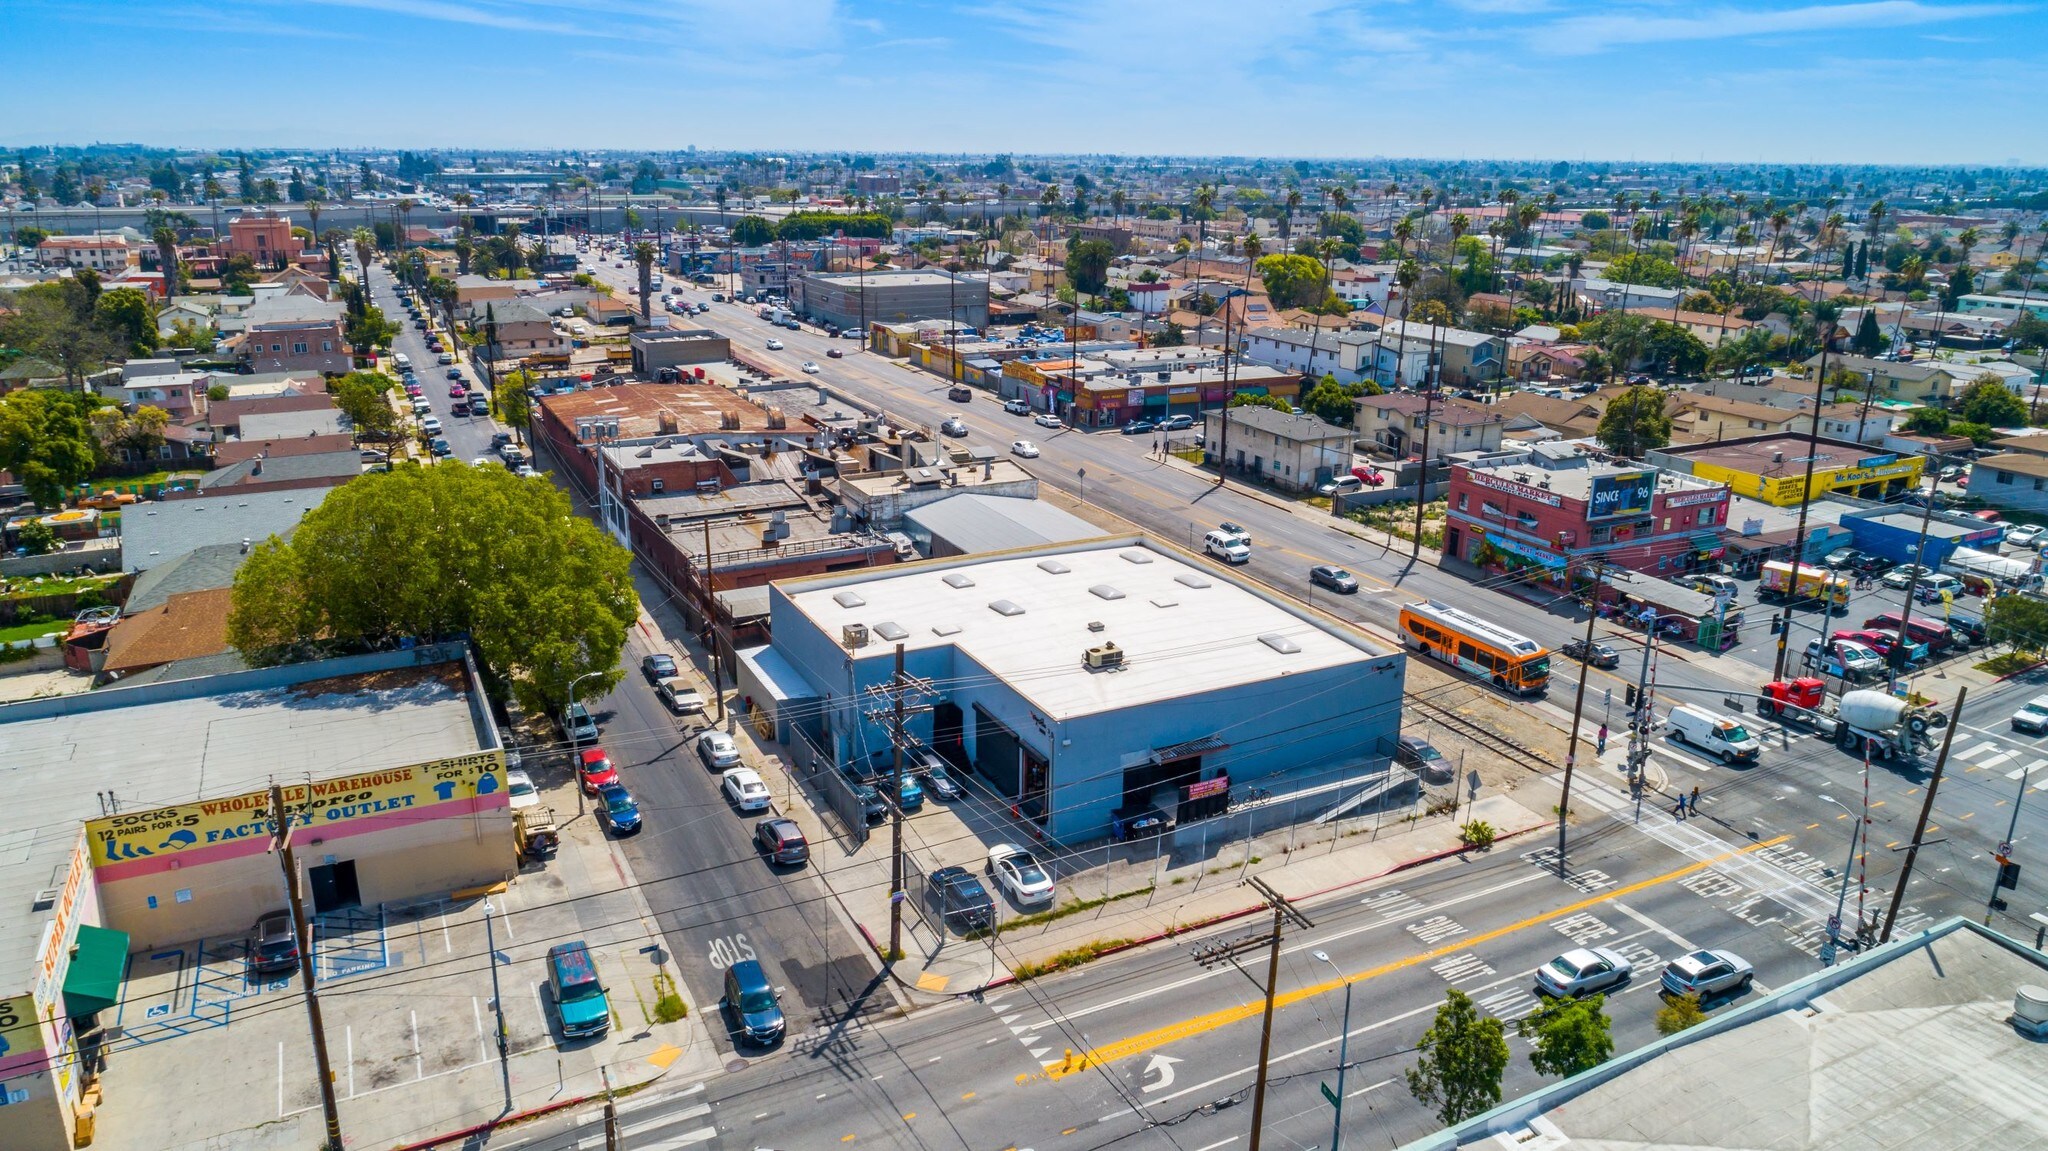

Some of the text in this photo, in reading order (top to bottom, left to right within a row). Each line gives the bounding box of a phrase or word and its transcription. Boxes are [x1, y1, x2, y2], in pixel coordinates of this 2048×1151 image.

[1475, 473, 1552, 501] HERCULES MARKET
[1595, 486, 1649, 504] SINCE 96
[421, 754, 496, 773] T-SHIRTS
[437, 770, 463, 780] FOR
[201, 769, 413, 817] WHOLESLE WAREHOUSE
[97, 829, 116, 842] 12
[117, 825, 148, 837] PAIRS
[151, 820, 173, 831] FOR
[112, 808, 178, 828] SOCKS
[206, 795, 415, 843] FACTOY OUTLET
[1677, 868, 1743, 898] KEEP
[44, 910, 65, 979] SUPER
[63, 851, 84, 915] OUTLET
[1550, 912, 1618, 946] HERE
[708, 933, 757, 969] STOP
[341, 961, 377, 974] PARKING
[1430, 952, 1497, 986] WAIT
